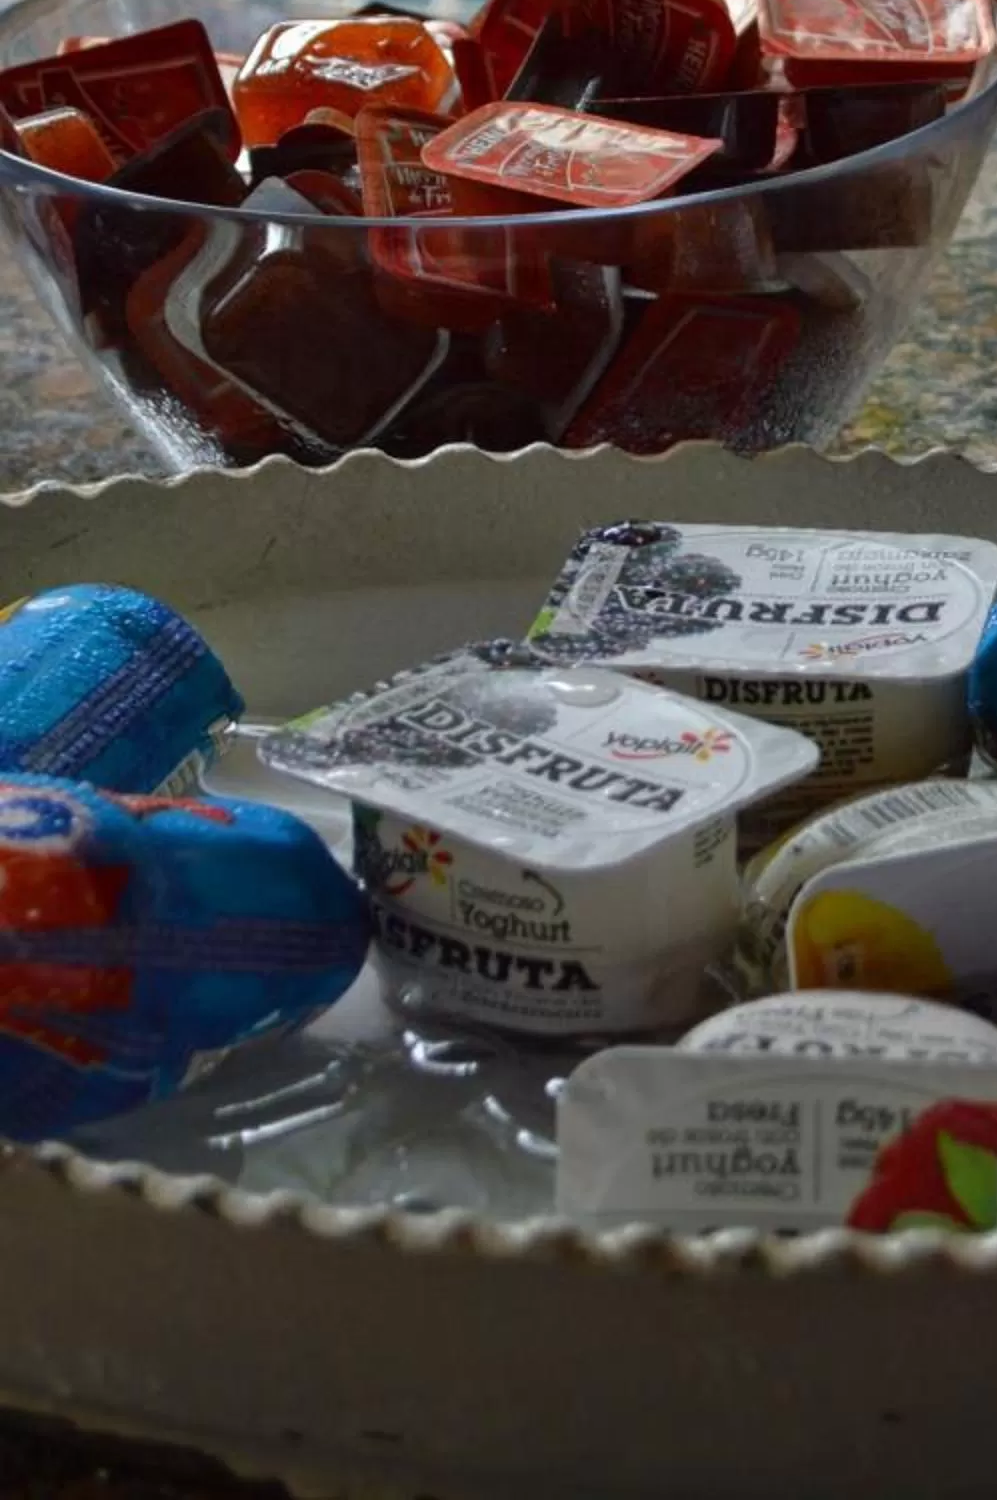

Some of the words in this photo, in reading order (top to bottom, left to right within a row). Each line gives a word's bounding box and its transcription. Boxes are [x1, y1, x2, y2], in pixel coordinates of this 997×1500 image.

[614, 583, 946, 625] DISFRUTA
[703, 676, 874, 705] DISFRUTA
[406, 697, 688, 813] DISFRUTA
[601, 729, 704, 758] yoplait
[459, 900, 573, 944] Yoghurt
